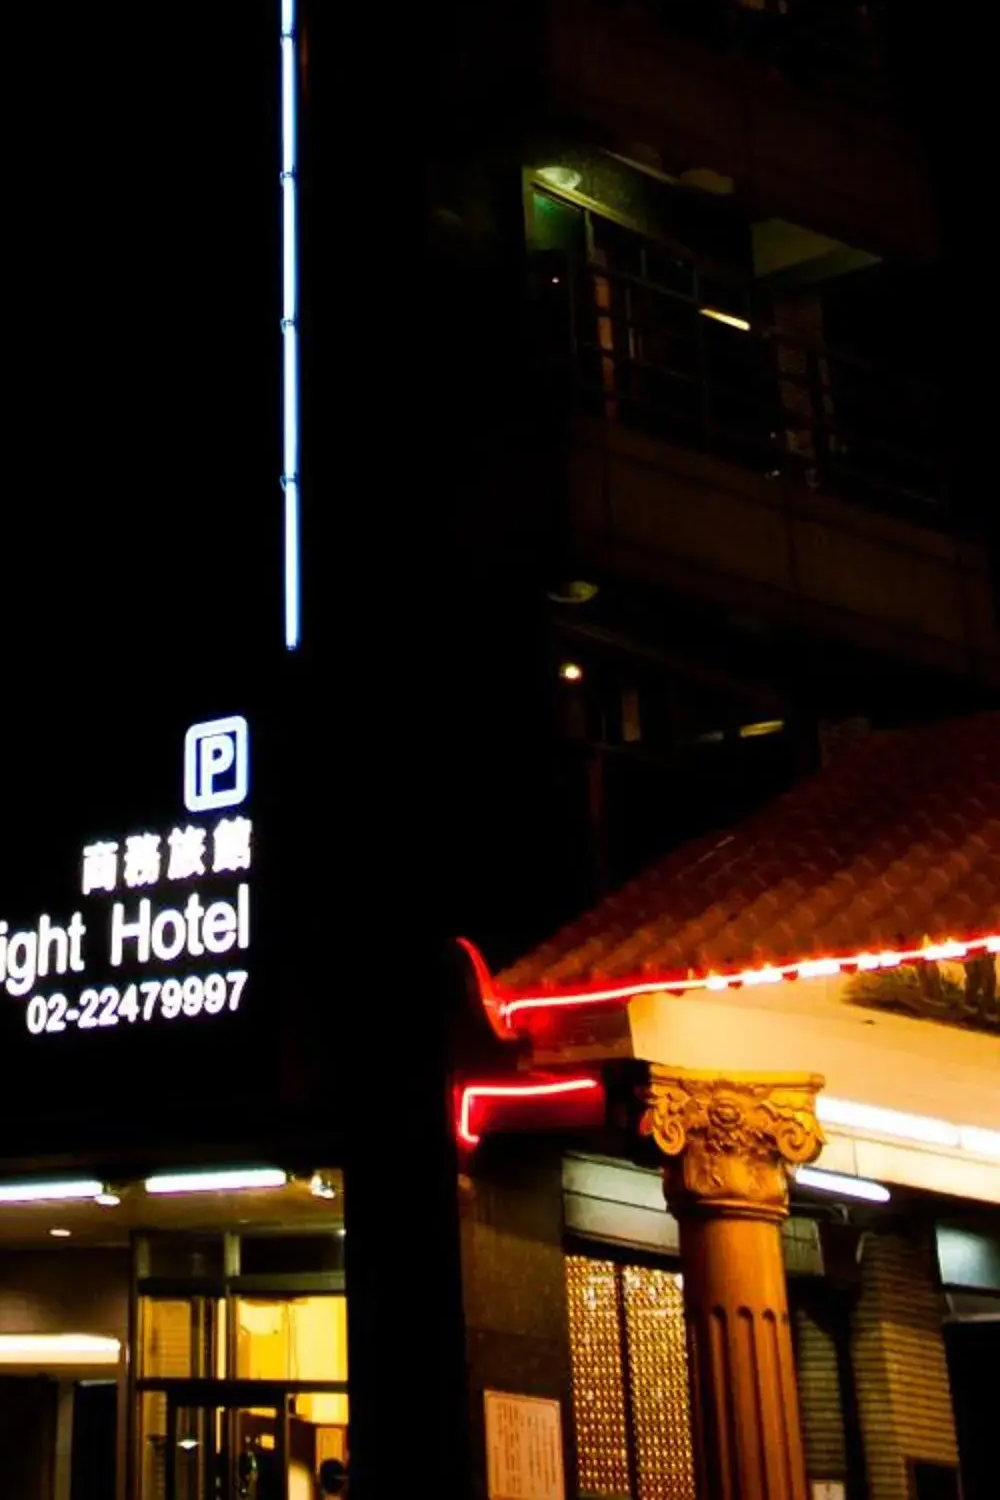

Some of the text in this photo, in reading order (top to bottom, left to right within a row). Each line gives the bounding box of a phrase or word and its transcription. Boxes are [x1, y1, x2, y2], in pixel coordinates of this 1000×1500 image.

[82, 815, 251, 895] 商務旅館
[110, 883, 250, 967] Hotel
[26, 970, 249, 1034] 02-22479997
